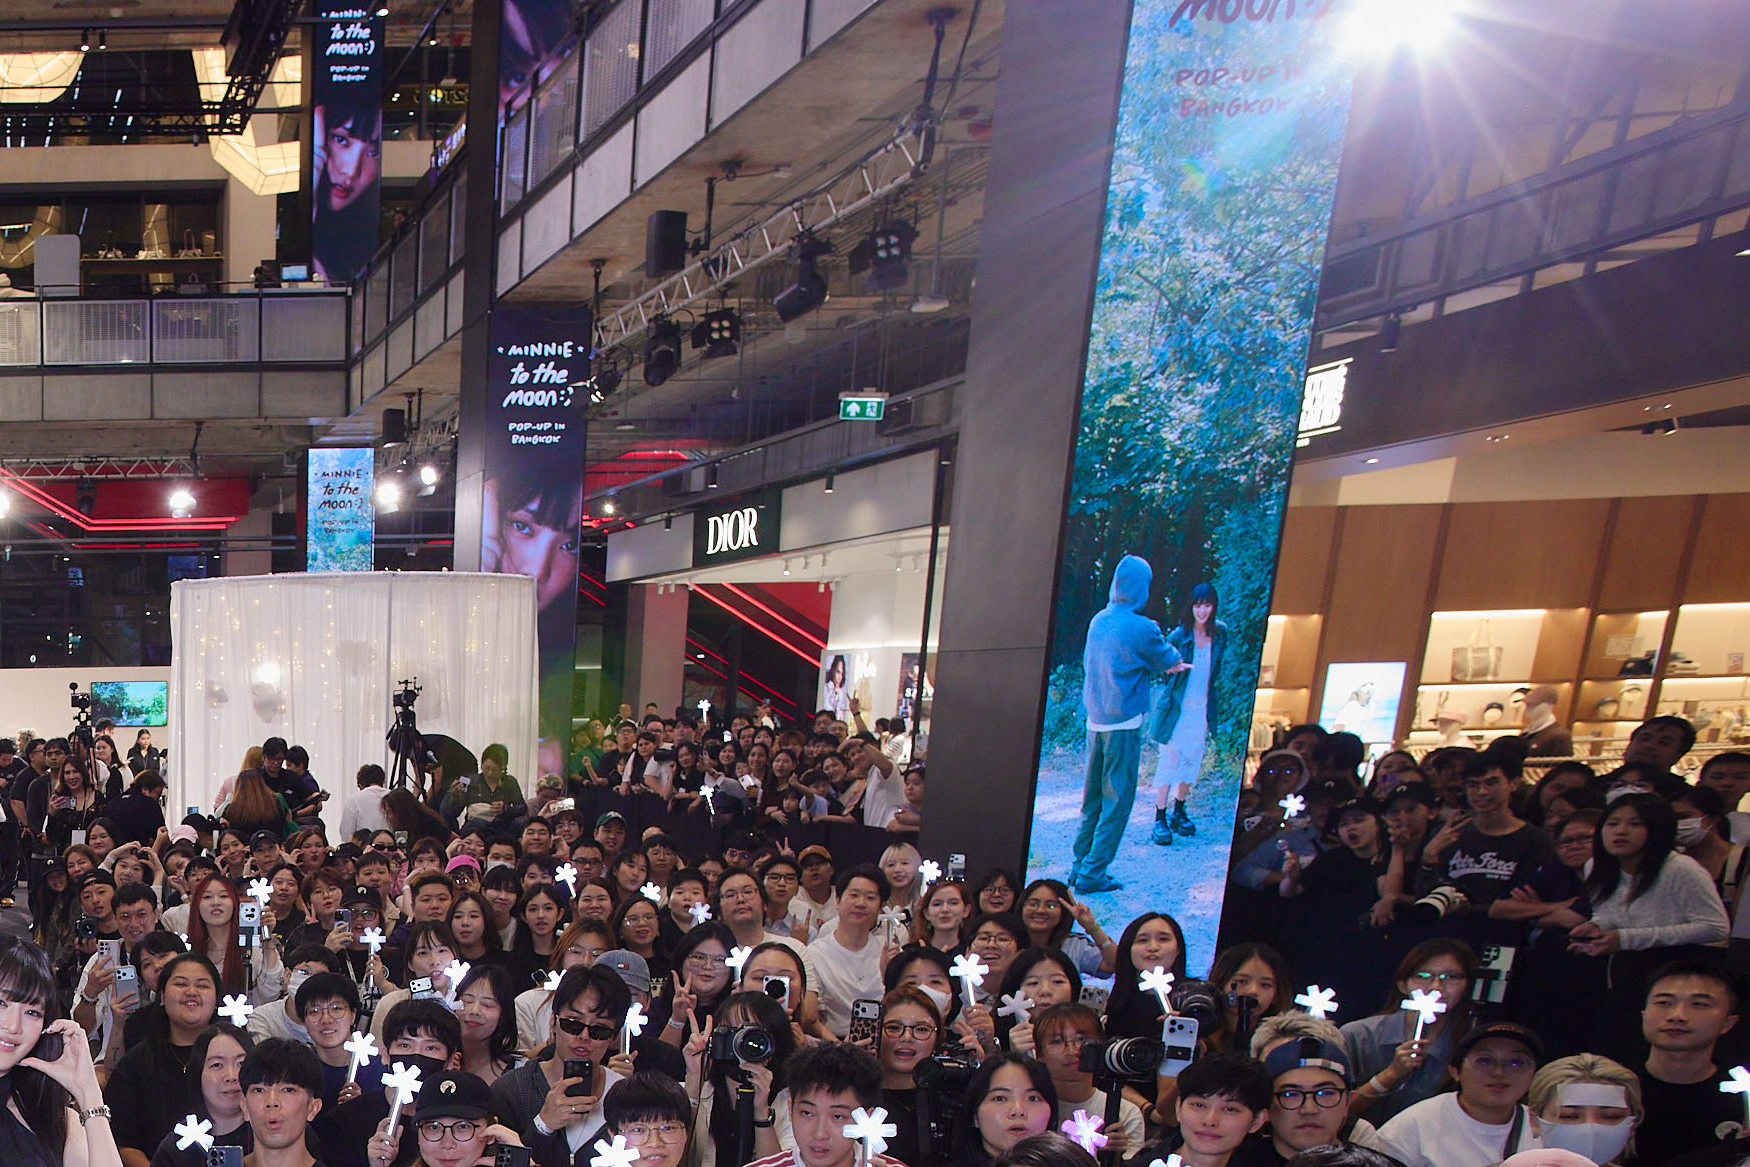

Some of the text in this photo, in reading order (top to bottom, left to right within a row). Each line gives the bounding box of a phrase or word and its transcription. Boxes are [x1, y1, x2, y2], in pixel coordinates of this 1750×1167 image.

[331, 22, 371, 40] to the
[1175, 66, 1276, 87] POP-UP
[1179, 98, 1293, 119] BANGKOK
[507, 340, 575, 360] MINNIE
[509, 360, 570, 386] to the
[507, 421, 567, 433] POP-UP IN
[511, 434, 562, 446] BANGKOK
[320, 468, 363, 480] MINNIE
[322, 480, 361, 496] to the
[706, 507, 759, 555] DIOR
[1449, 849, 1475, 871] Air
